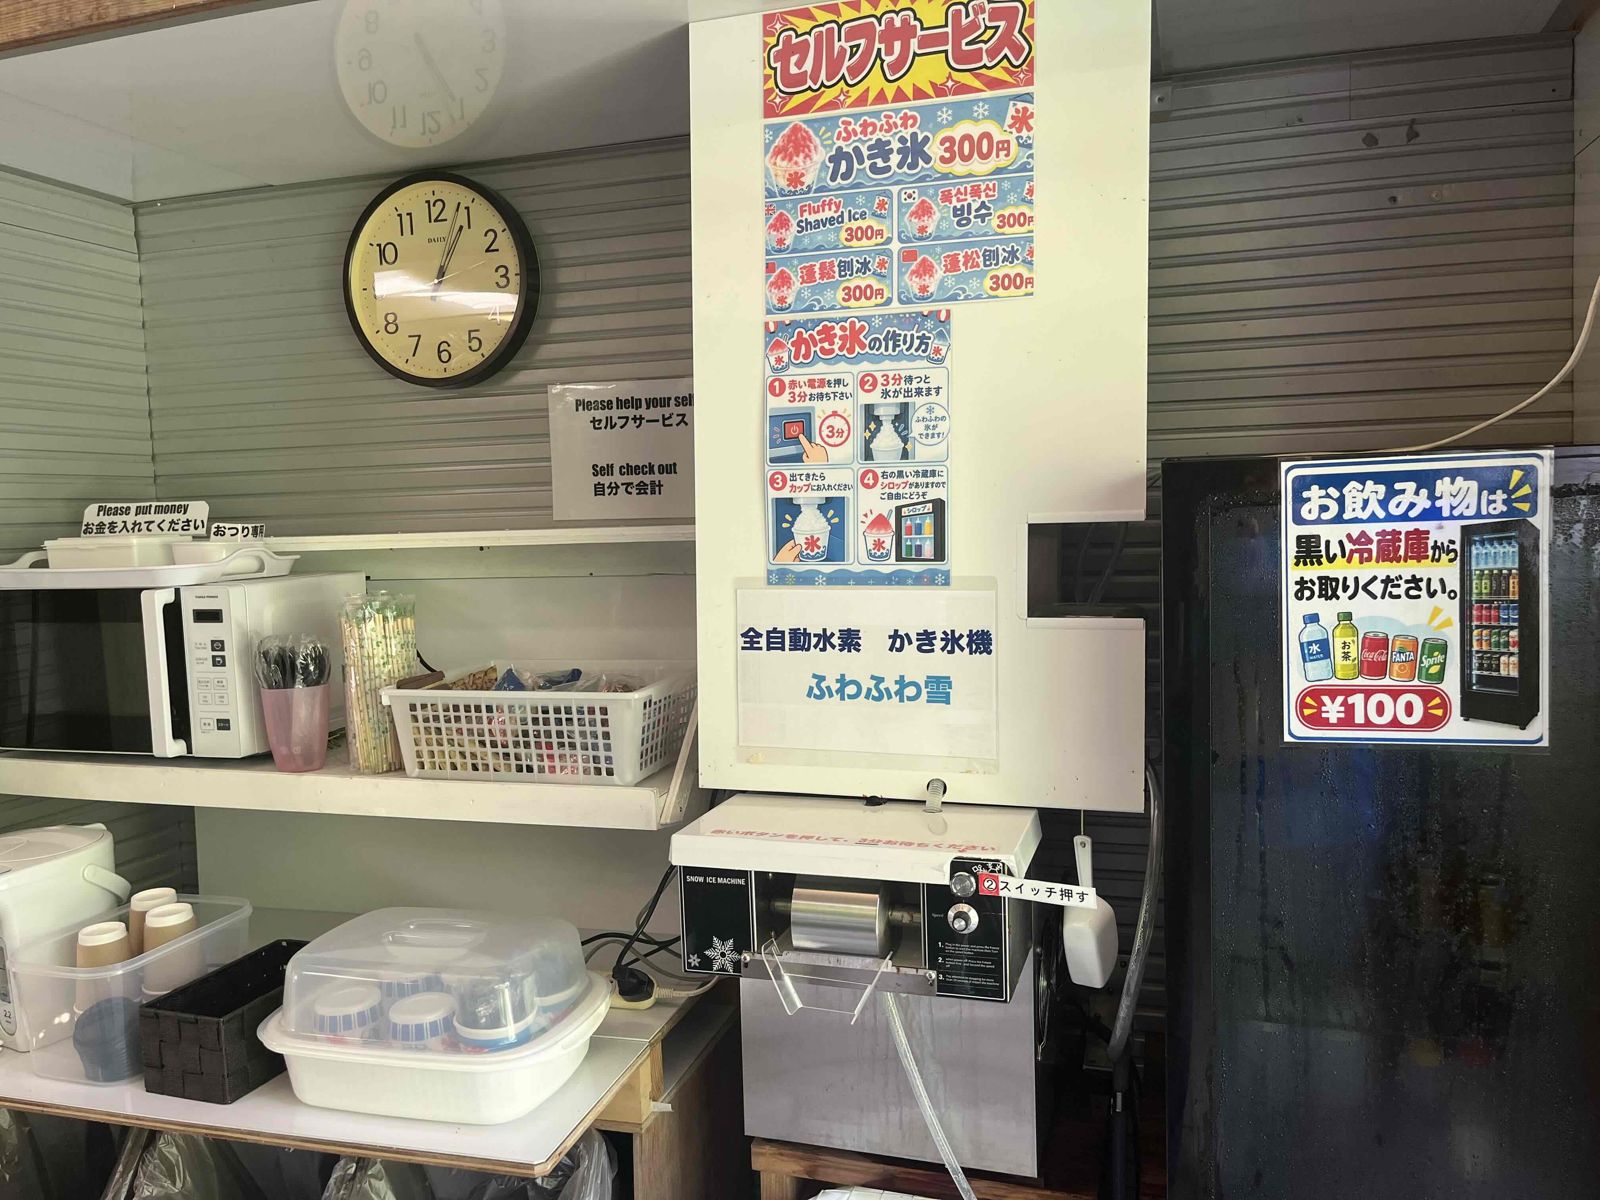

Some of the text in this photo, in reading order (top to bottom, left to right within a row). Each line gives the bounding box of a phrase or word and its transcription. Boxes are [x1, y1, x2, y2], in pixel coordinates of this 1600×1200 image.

[768, 0, 1031, 94] セルフサービス
[836, 111, 919, 142] ふわふわ
[1008, 106, 1034, 134] 氷
[828, 131, 1011, 182] かき氷 300円
[939, 183, 996, 205] 폭신폭신
[425, 199, 448, 223] 12
[464, 206, 471, 229] 1
[799, 198, 842, 218] Fluffy
[952, 201, 993, 227] 빙수
[397, 212, 414, 236] 11
[796, 209, 867, 234] Shaved Ice
[427, 236, 447, 244] DAILY
[484, 229, 499, 253] 2
[844, 225, 884, 243] 300円
[376, 242, 398, 265] 10
[494, 265, 510, 289] 3
[841, 284, 884, 303] 300円
[384, 312, 399, 335] 8
[408, 335, 422, 357] 7
[467, 329, 482, 352] 5
[791, 320, 932, 361] かき氷の作り方
[437, 341, 452, 363] 6
[788, 378, 849, 391] 赤い電源を押し
[881, 373, 931, 387] 3分待つと
[575, 393, 695, 412] Please help your sel
[788, 391, 853, 403] 3分お待ち下さい
[881, 386, 943, 399] 氷が出来ます
[590, 413, 689, 431] セルフサービス
[826, 425, 845, 439] 3分
[592, 462, 678, 477] Self check out
[789, 473, 826, 482] 出てきたら
[881, 470, 944, 479] 右の黒い冷蔵庫に
[593, 480, 664, 497] 自分で会計
[789, 483, 853, 493] カップにお入れください
[880, 480, 946, 491] シロップがありますので
[880, 491, 928, 500] ご自由にどうぞ
[1299, 475, 1508, 521] お飲み物は
[97, 503, 189, 517] Please put money
[83, 519, 205, 535] お金を入れてください
[1294, 528, 1459, 567] 黒い冷蔵庫から
[1294, 574, 1458, 601] お取りください。
[740, 627, 993, 655] 全自動水素 かき氷機
[1308, 643, 1321, 654] 水
[1341, 640, 1352, 662] お茶
[1392, 651, 1415, 662] FANTA
[1421, 652, 1445, 667] Sprite
[806, 673, 952, 705] ふわふわ雪
[1320, 693, 1424, 725] ¥100
[686, 875, 746, 885] SNOW ICE MACHINE
[1000, 879, 1089, 903] スイッチ押す
